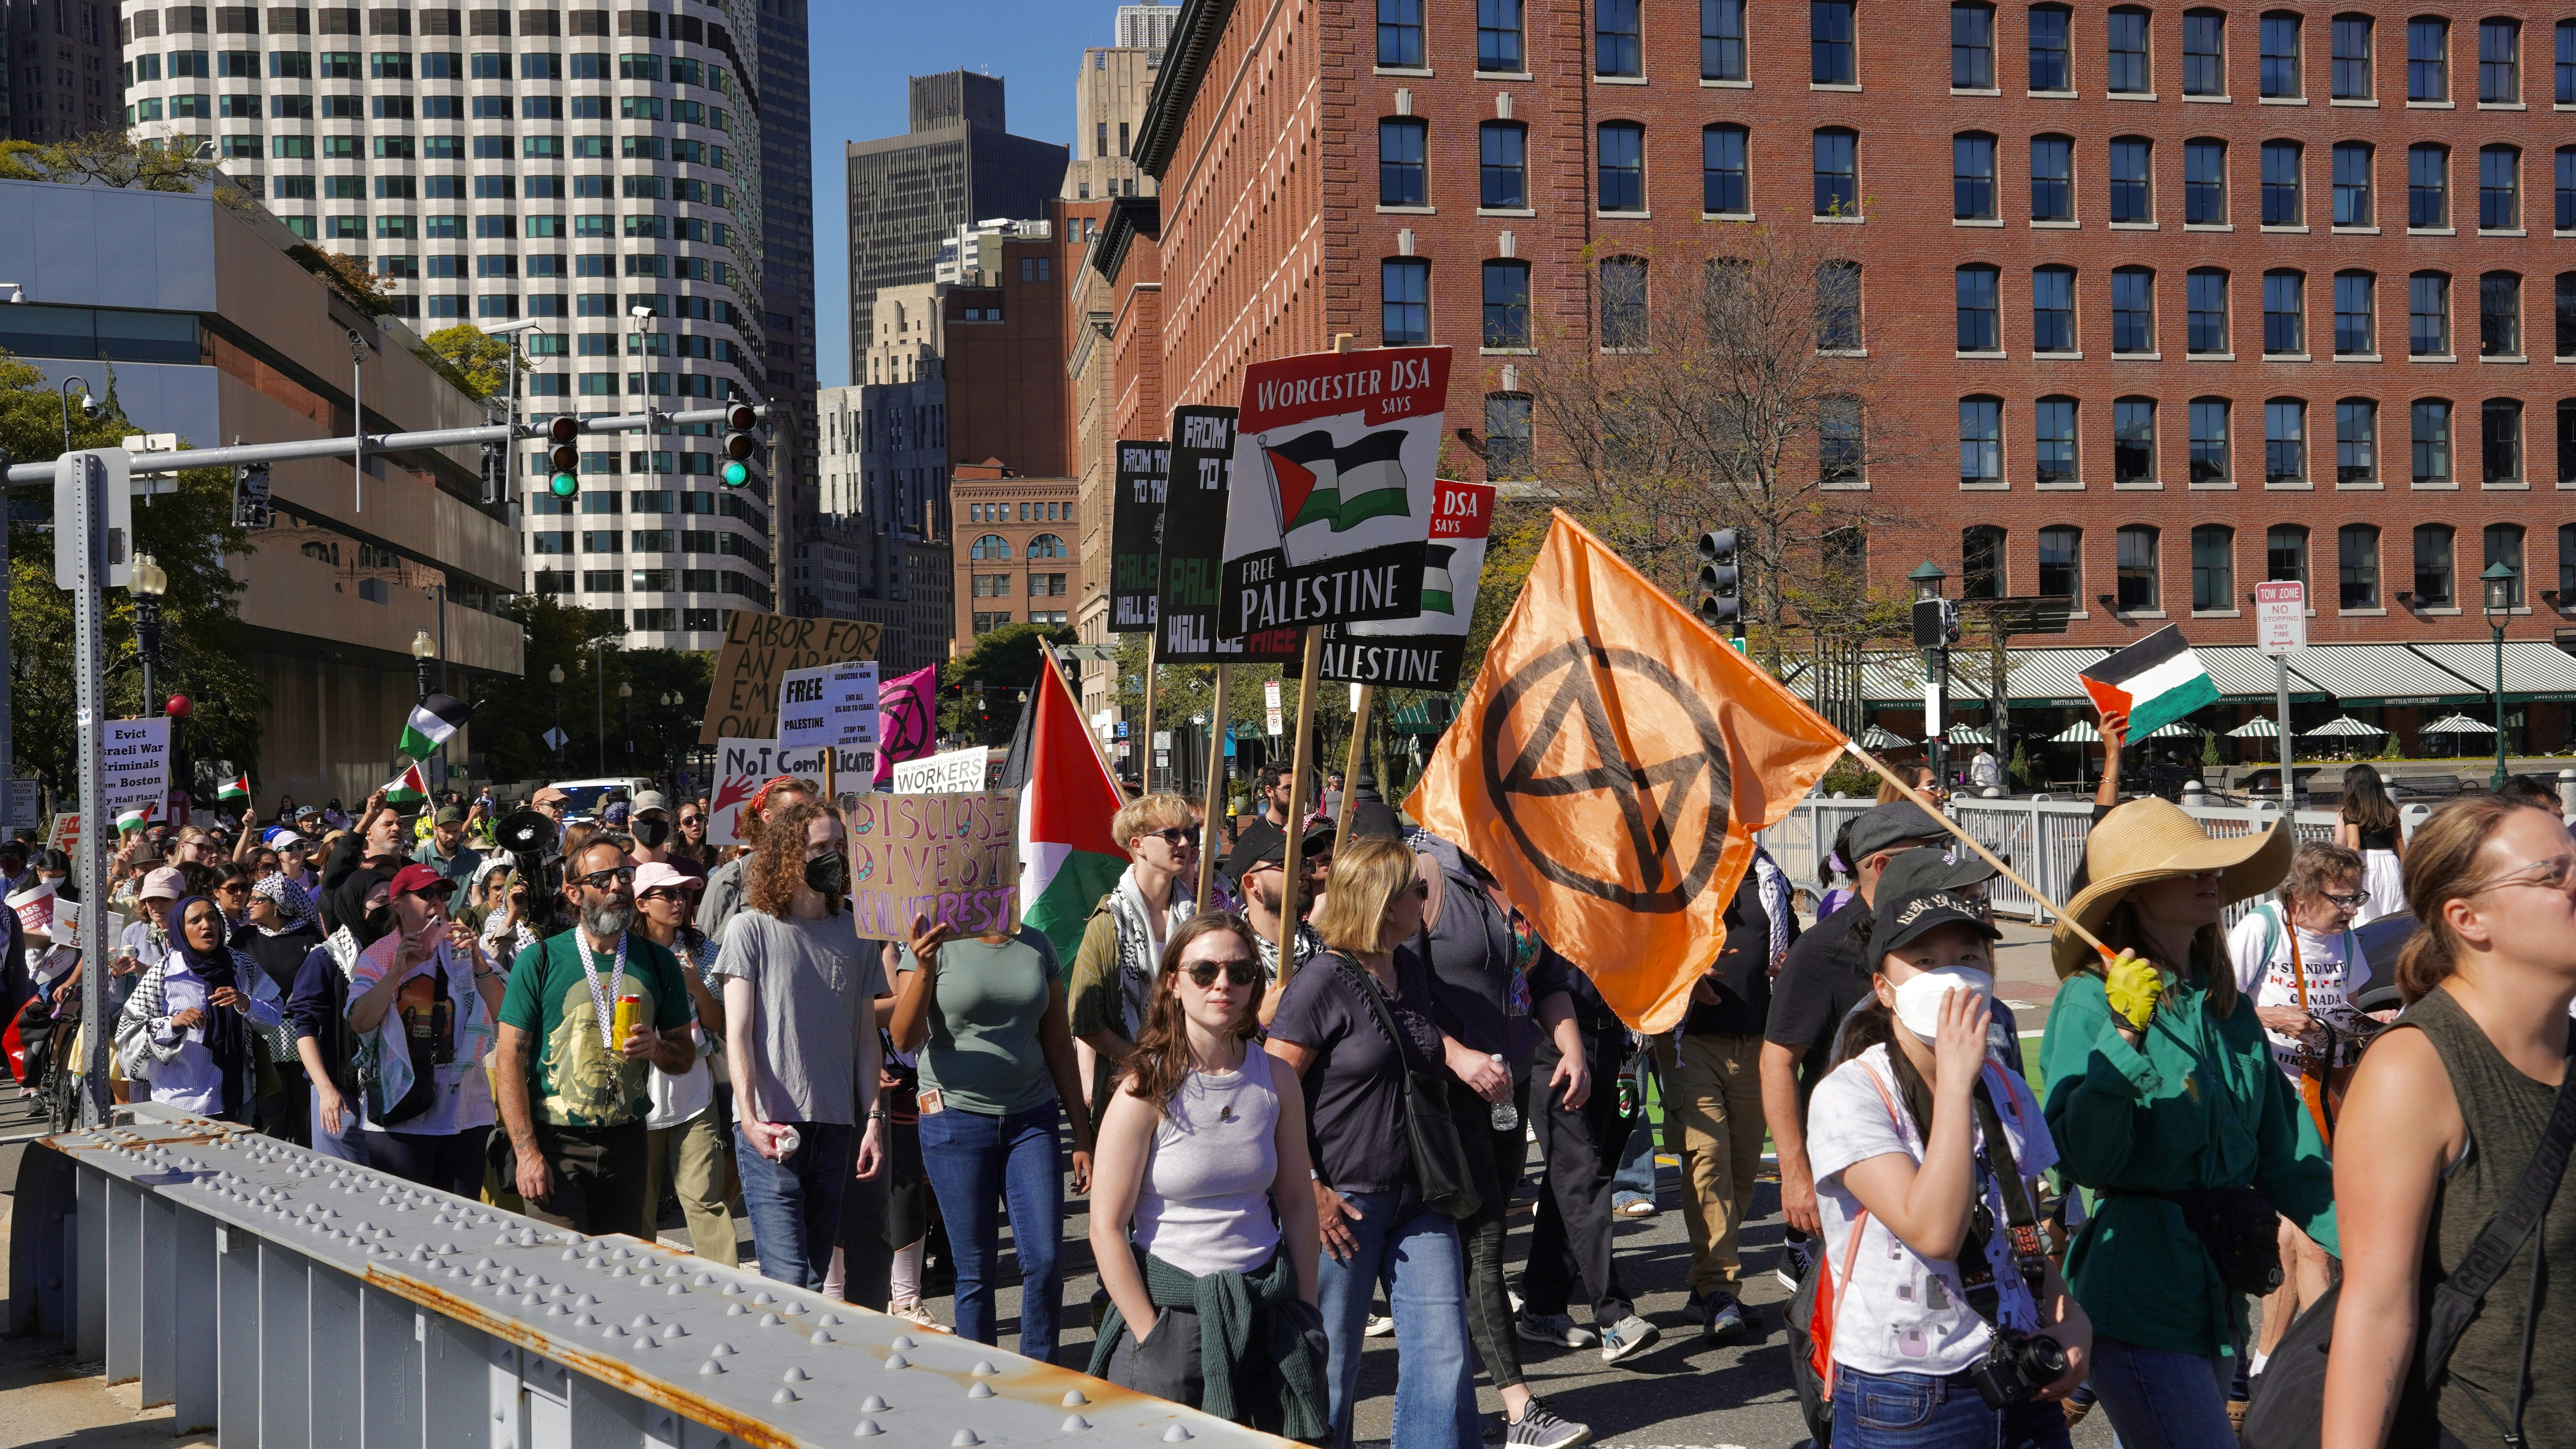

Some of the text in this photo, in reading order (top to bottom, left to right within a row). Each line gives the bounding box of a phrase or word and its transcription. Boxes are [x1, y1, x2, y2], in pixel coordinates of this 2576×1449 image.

[1258, 358, 1431, 412] WORCESTER DSA
[1382, 395, 1411, 415] SAYS
[1183, 416, 1228, 449] FROM
[1123, 448, 1171, 473] FROM TH
[1198, 458, 1220, 490] TO
[1133, 479, 1167, 503] TO TH
[1443, 491, 1477, 517] DSA
[1434, 518, 1461, 533] SAYS
[1118, 554, 1159, 589] PALE
[1242, 556, 1276, 585] FREE
[1241, 564, 1400, 633] PALESTINE
[2260, 588, 2299, 600] TOW ZONE
[1147, 595, 1157, 624] B
[2272, 605, 2289, 614] NO
[727, 611, 879, 655] LABOR FOR
[1323, 623, 1338, 640] EE
[734, 647, 776, 682] AN
[1319, 643, 1443, 682] ALESTINE
[835, 673, 859, 681] GENOCIDE
[786, 677, 823, 704] FREE
[115, 729, 146, 740] Evict
[784, 717, 824, 731] PALESTINE
[104, 744, 164, 755] sraeli War
[898, 758, 982, 792] WORKERS
[911, 761, 936, 771] WORKING
[938, 757, 956, 765] CLASS
[120, 776, 161, 788] Boston
[115, 795, 134, 804] Hall
[852, 796, 1011, 842] DISCLOSE
[54, 817, 68, 848] THER
[854, 841, 1010, 890] DIVEST
[21, 912, 43, 925] OTESTS
[852, 885, 1018, 939] WE WILL NOT REST
[1896, 898, 1934, 925] NEW
[24, 922, 39, 931] RIKES
[2270, 961, 2275, 970] I
[2281, 963, 2321, 974] STND
[2290, 994, 2342, 1005] CNADA
